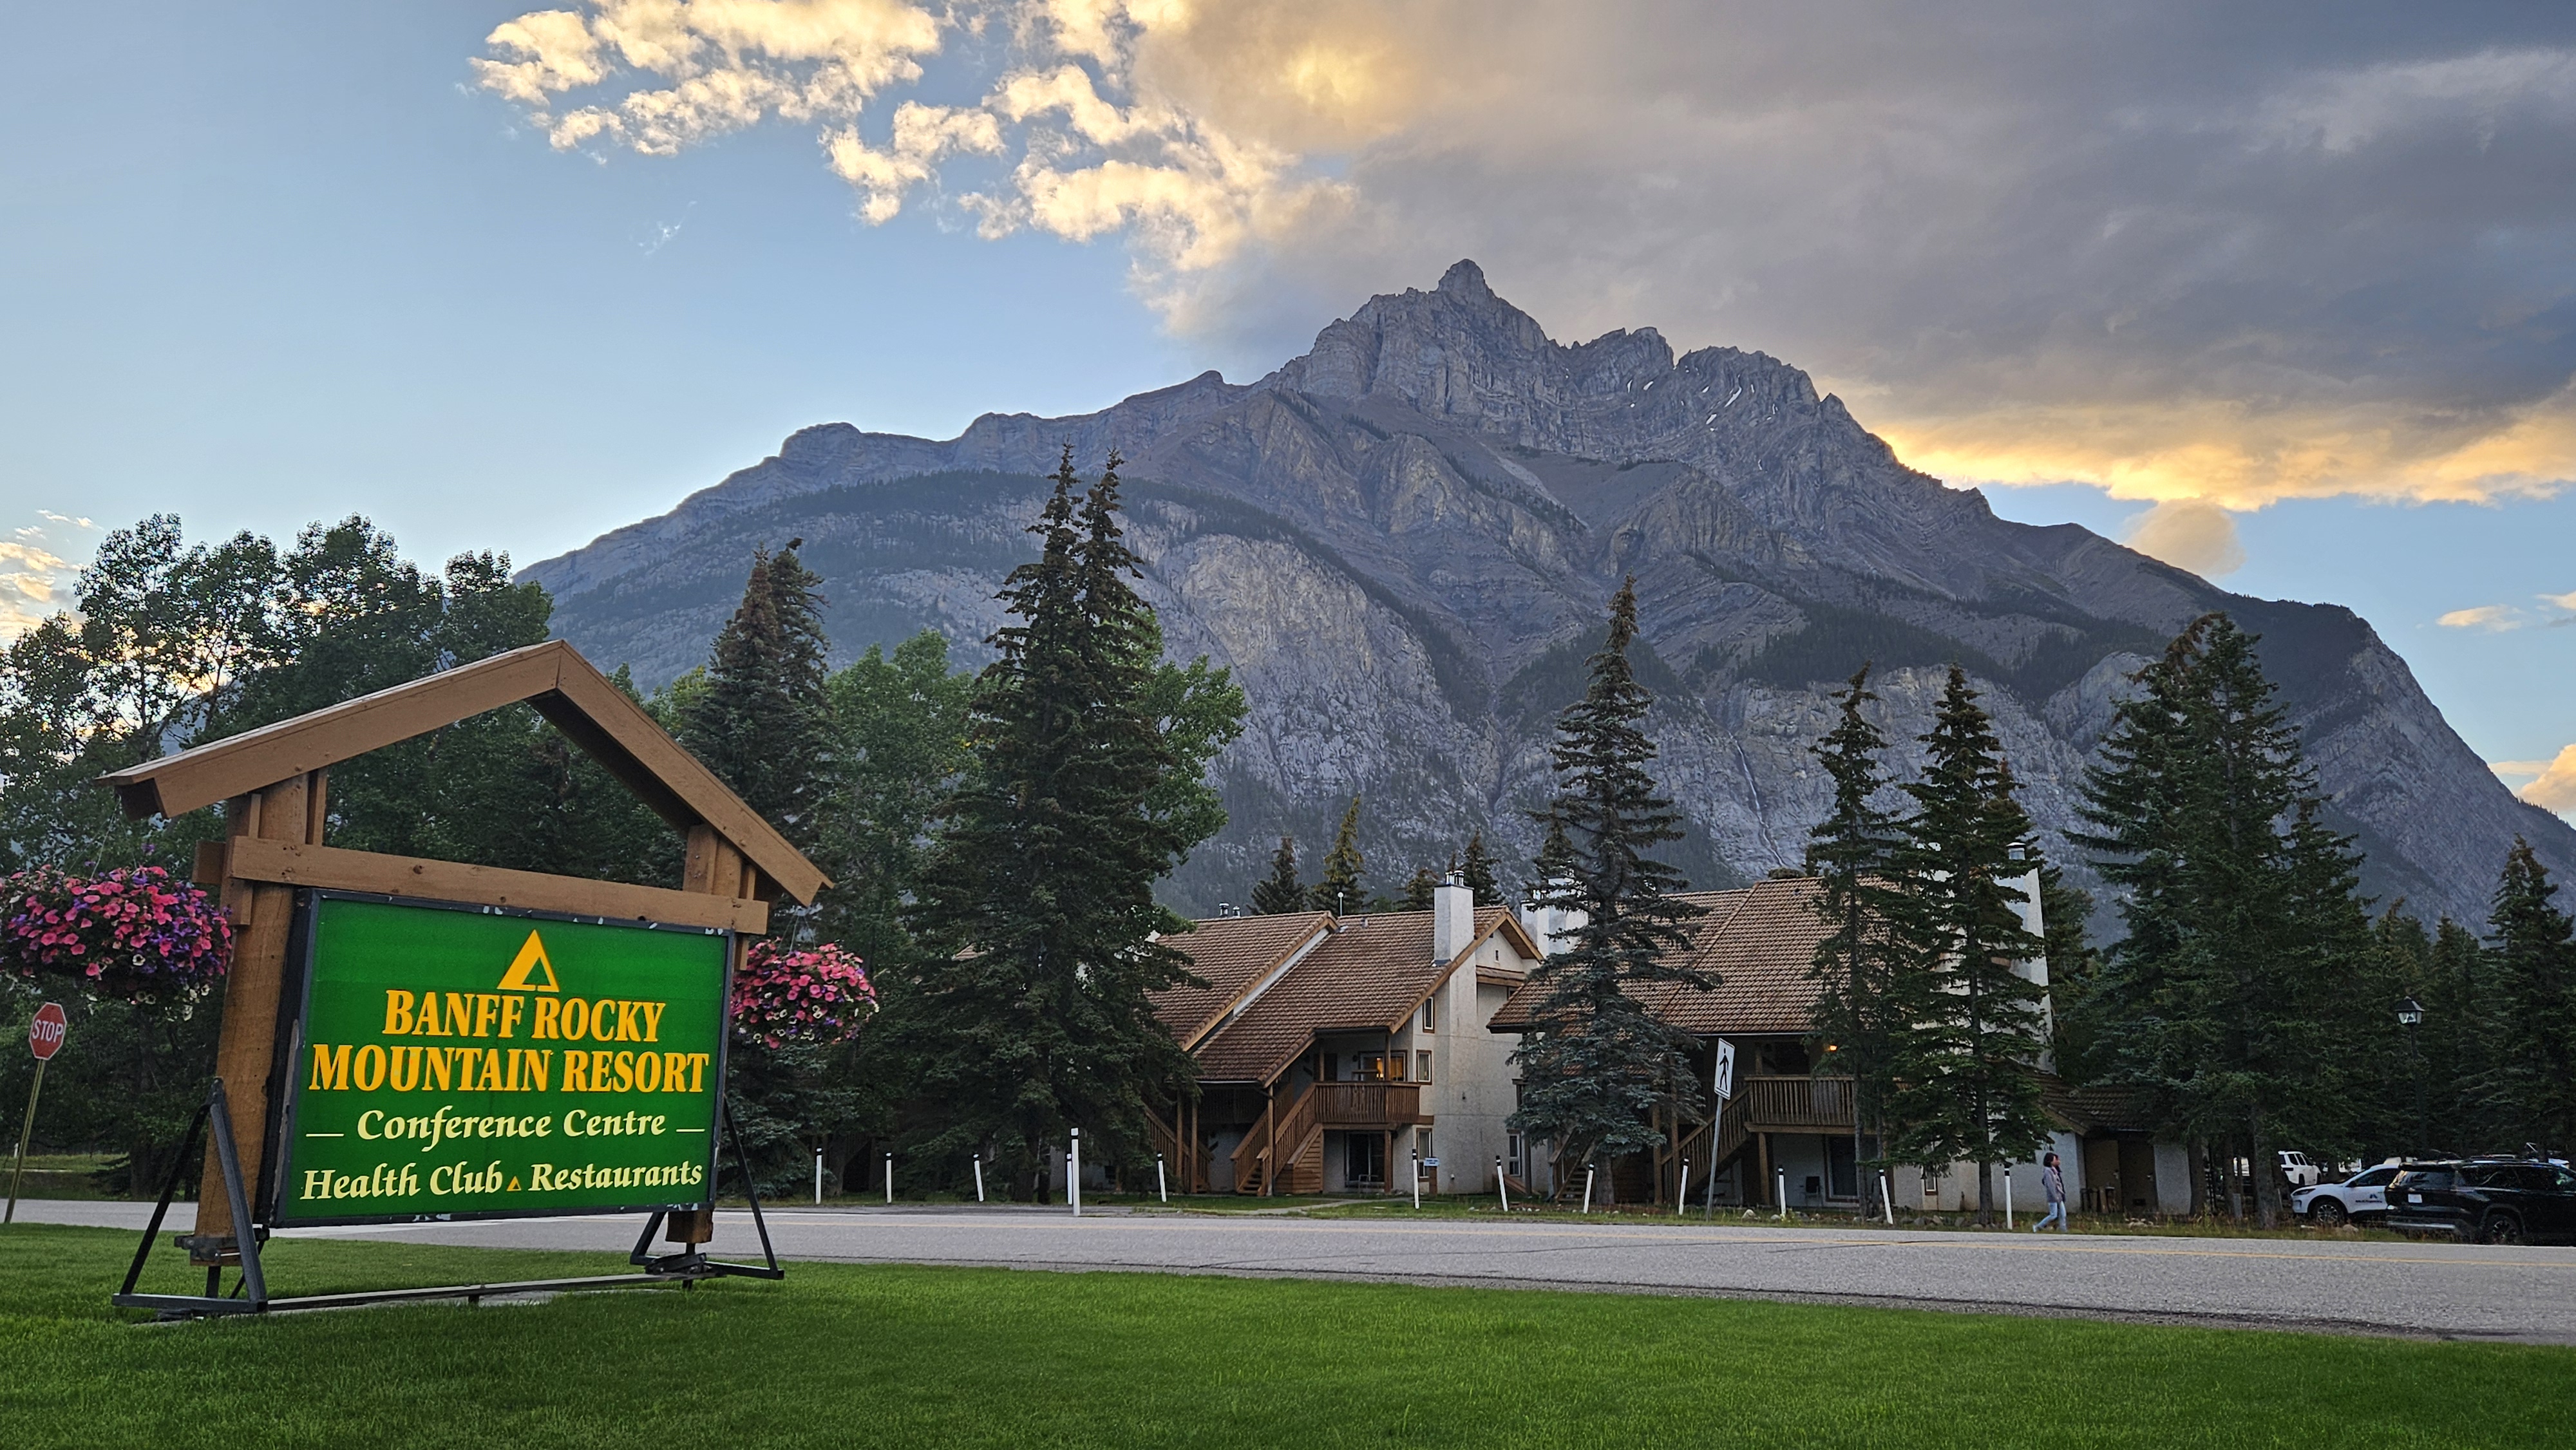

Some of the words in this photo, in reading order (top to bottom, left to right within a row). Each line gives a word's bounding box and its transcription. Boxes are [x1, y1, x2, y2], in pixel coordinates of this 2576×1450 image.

[32, 1019, 63, 1042] STOP
[383, 990, 524, 1038] BANFF
[531, 997, 666, 1042] ROCKY
[308, 1044, 553, 1092] MOUNTAIN
[560, 1050, 709, 1093] RESORT
[357, 1105, 552, 1152] Conference
[564, 1109, 667, 1137] Centre
[299, 1162, 421, 1200] Health
[430, 1160, 503, 1195] Club
[527, 1160, 703, 1191] Restaurants
